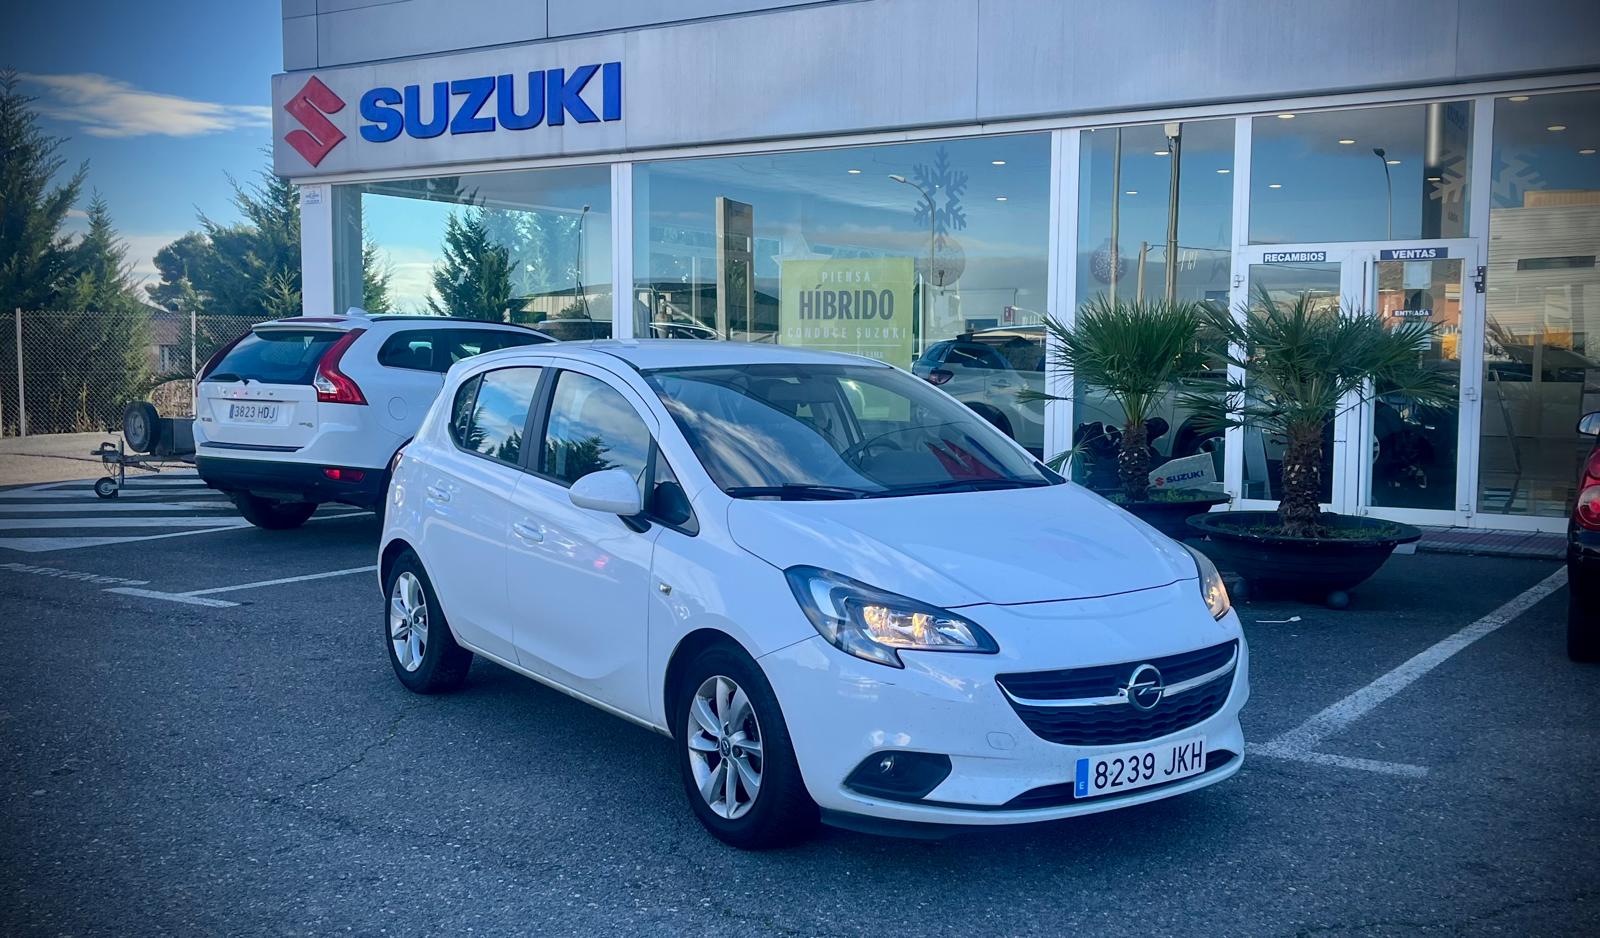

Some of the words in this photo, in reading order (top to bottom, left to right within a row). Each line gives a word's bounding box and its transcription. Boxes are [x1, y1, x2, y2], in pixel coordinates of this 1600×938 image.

[359, 61, 622, 143] SUZUKI
[1264, 252, 1325, 263] RECAMBIOS
[1392, 249, 1437, 259] VENTAS
[821, 271, 871, 282] PIENSA
[799, 284, 894, 320] HÍBRIDO
[787, 327, 848, 338] CONDUCE
[856, 327, 906, 339] SUZUKI
[234, 405, 255, 418] 3823
[258, 406, 275, 419] HDJ
[1166, 470, 1204, 484] SUZUKI
[1080, 781, 1084, 789] E
[1094, 752, 1156, 789] 8239
[1164, 740, 1202, 775] JKH
